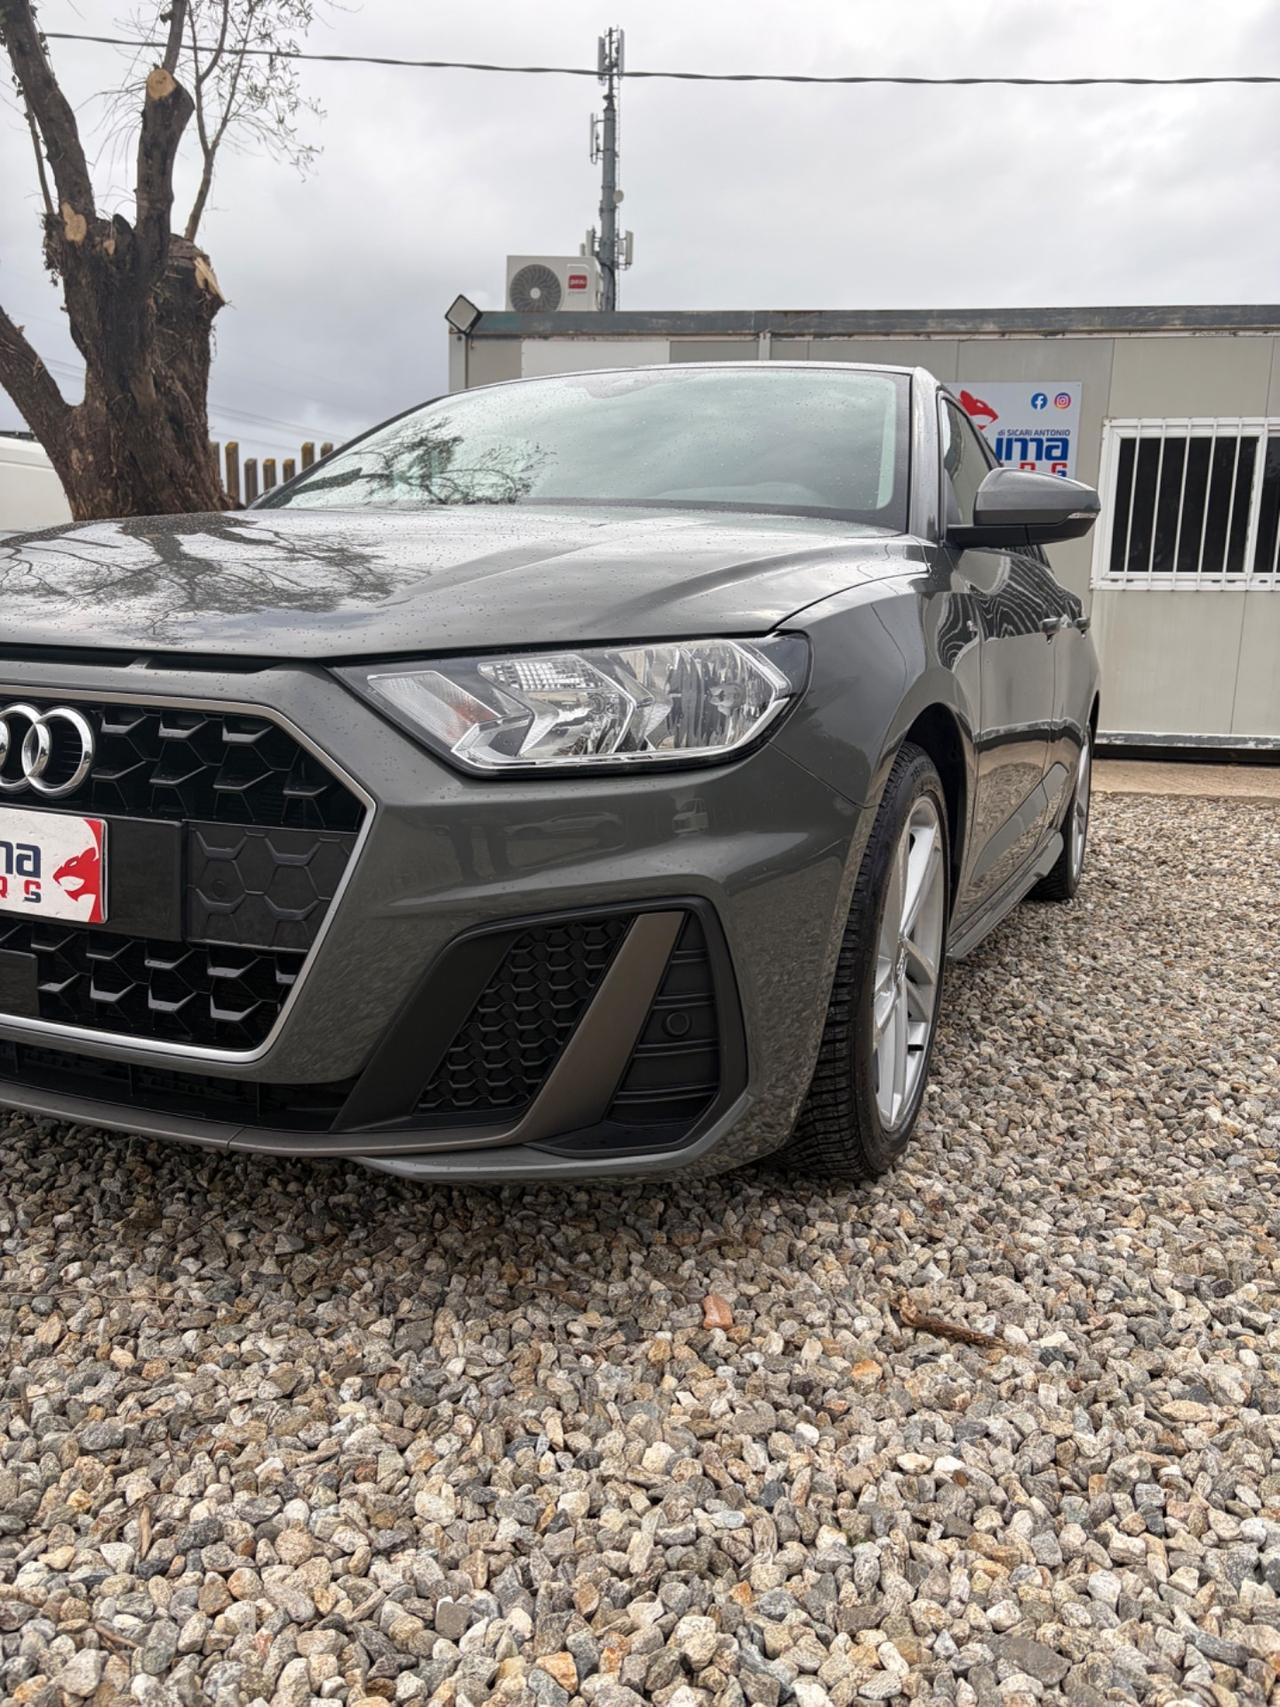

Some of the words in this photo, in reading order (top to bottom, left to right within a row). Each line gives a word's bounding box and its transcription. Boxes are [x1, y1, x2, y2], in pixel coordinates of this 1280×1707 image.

[998, 429, 1005, 437] di
[1007, 429, 1032, 437] SICARI
[1034, 429, 1071, 437] ANTONIO
